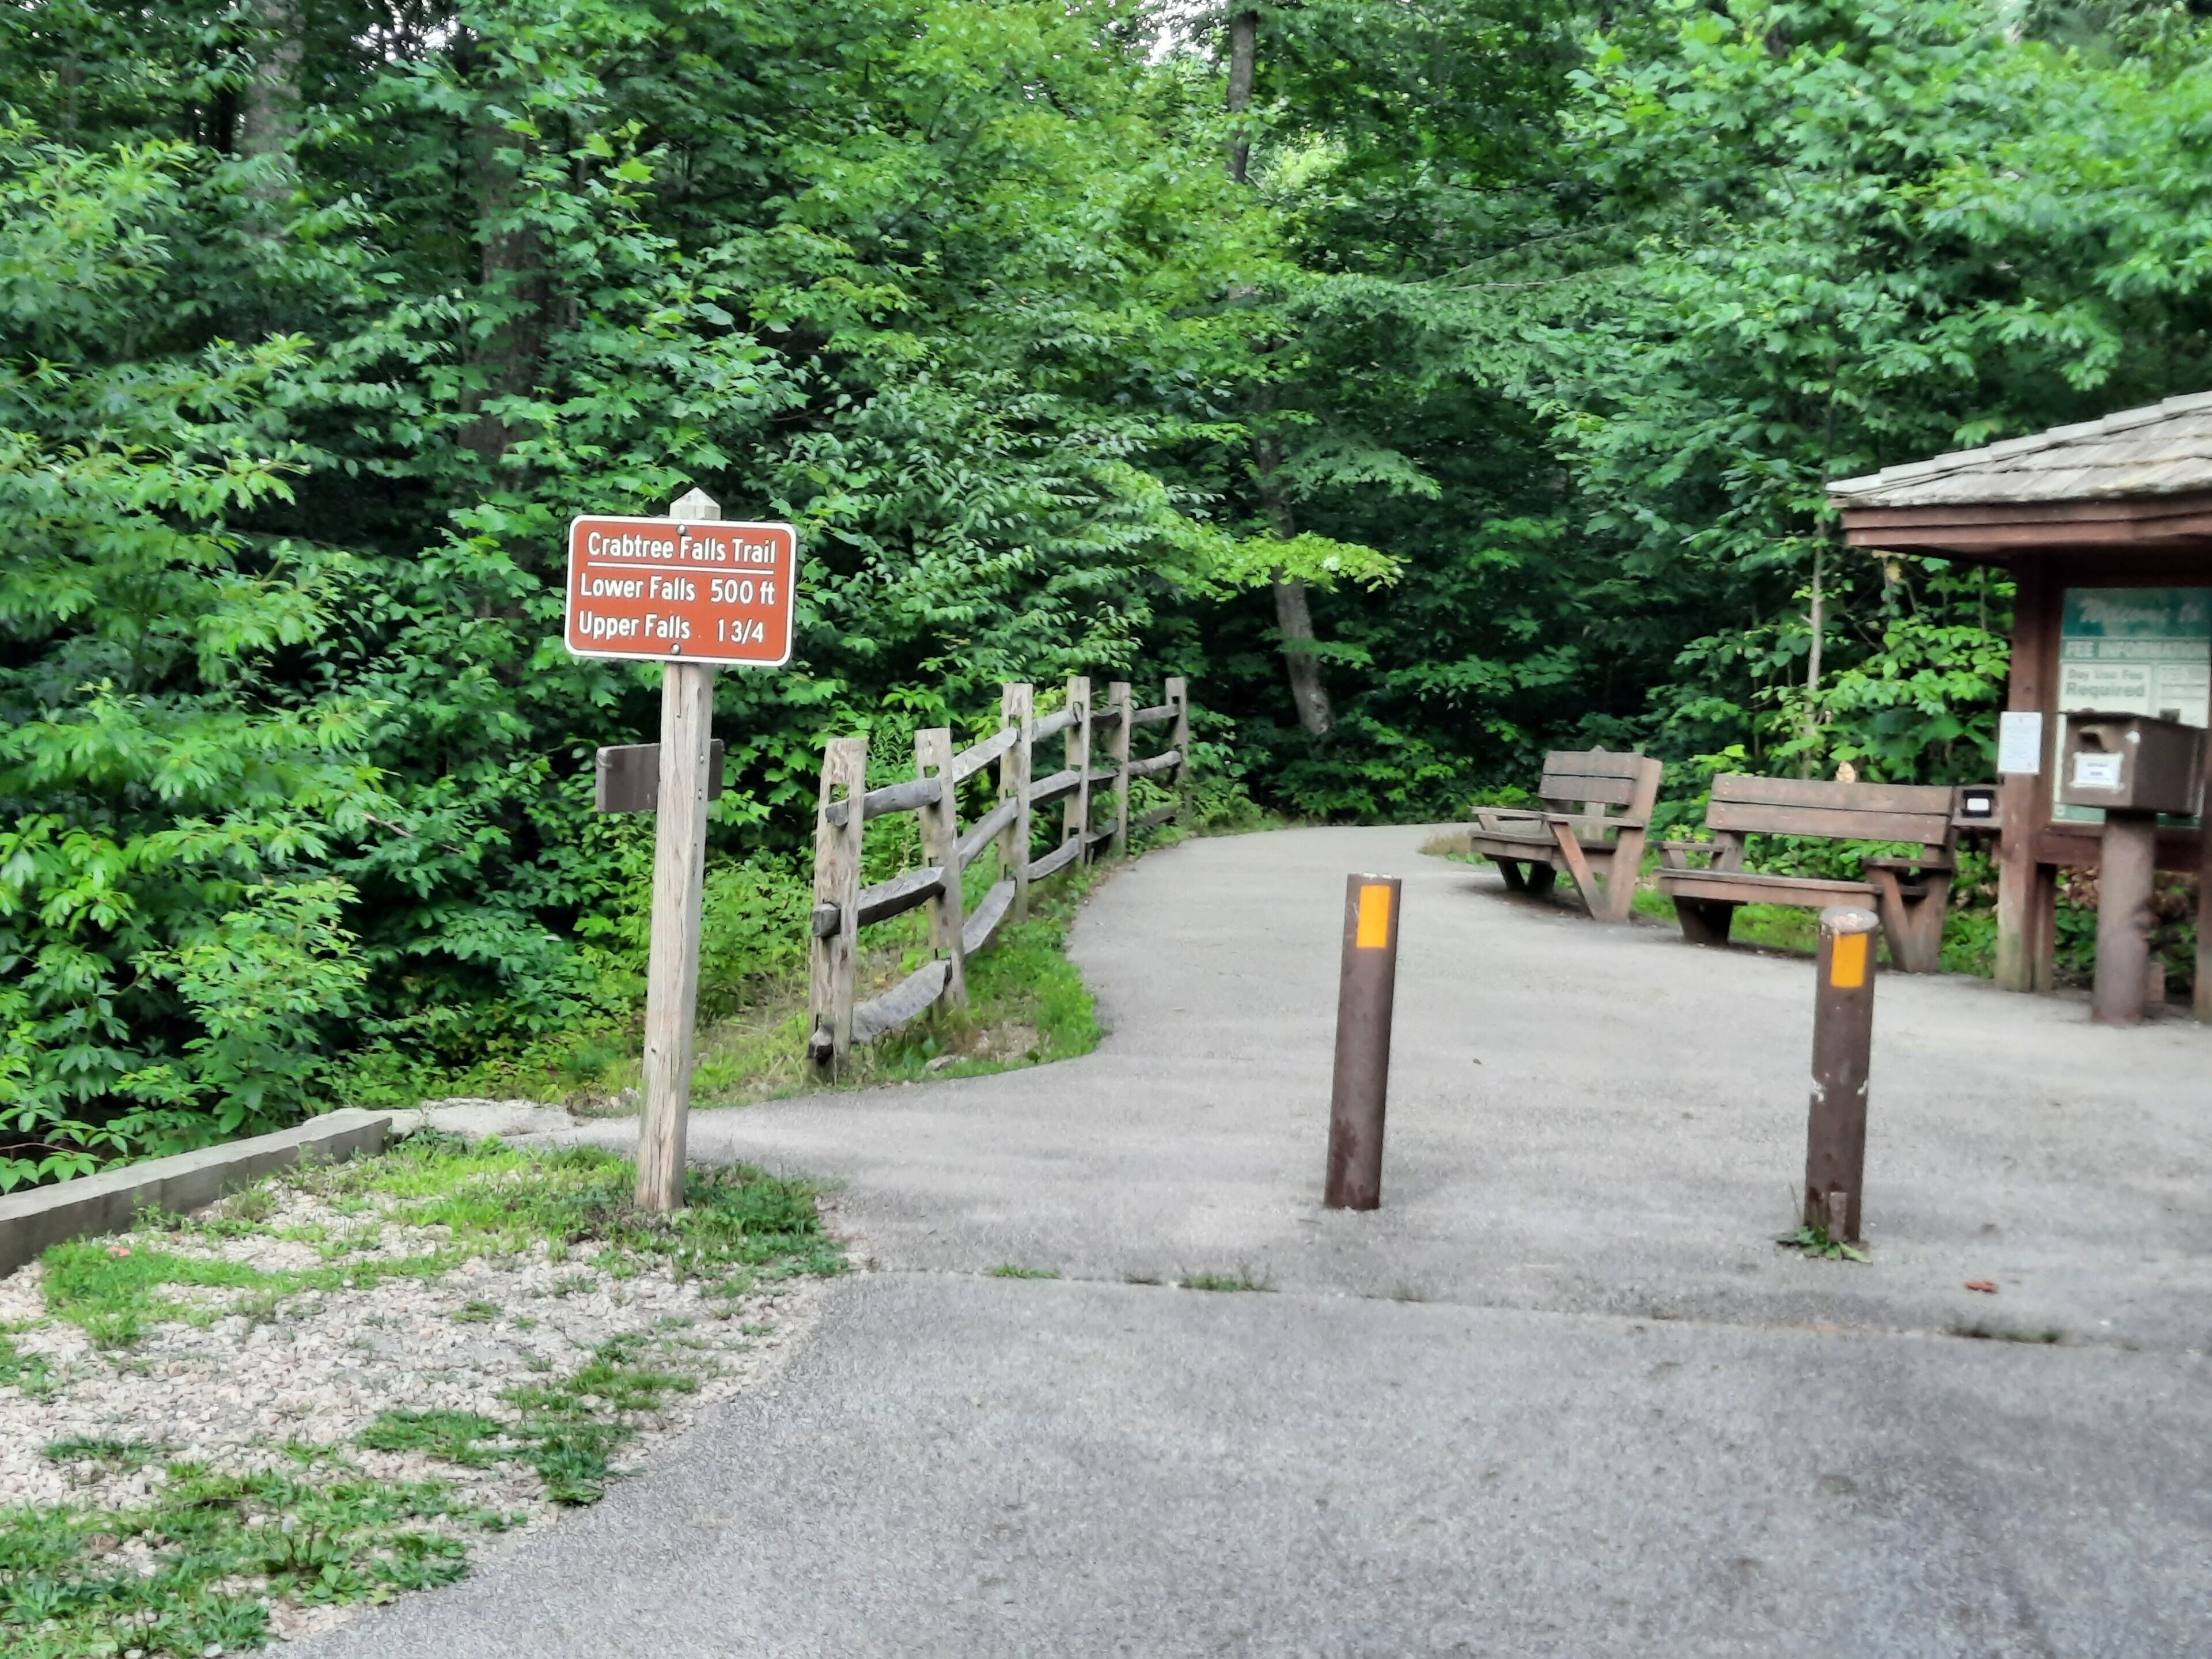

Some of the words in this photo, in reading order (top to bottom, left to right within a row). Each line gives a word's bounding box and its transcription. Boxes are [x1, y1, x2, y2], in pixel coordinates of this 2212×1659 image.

[588, 531, 673, 559] Crabtree
[679, 536, 726, 561] Falls
[732, 538, 776, 563] Trail
[580, 572, 643, 599] Lower
[649, 575, 696, 601] Falls
[710, 578, 753, 604] 500
[760, 581, 775, 605] ft
[578, 611, 639, 640] Upper
[645, 613, 691, 639] Falls
